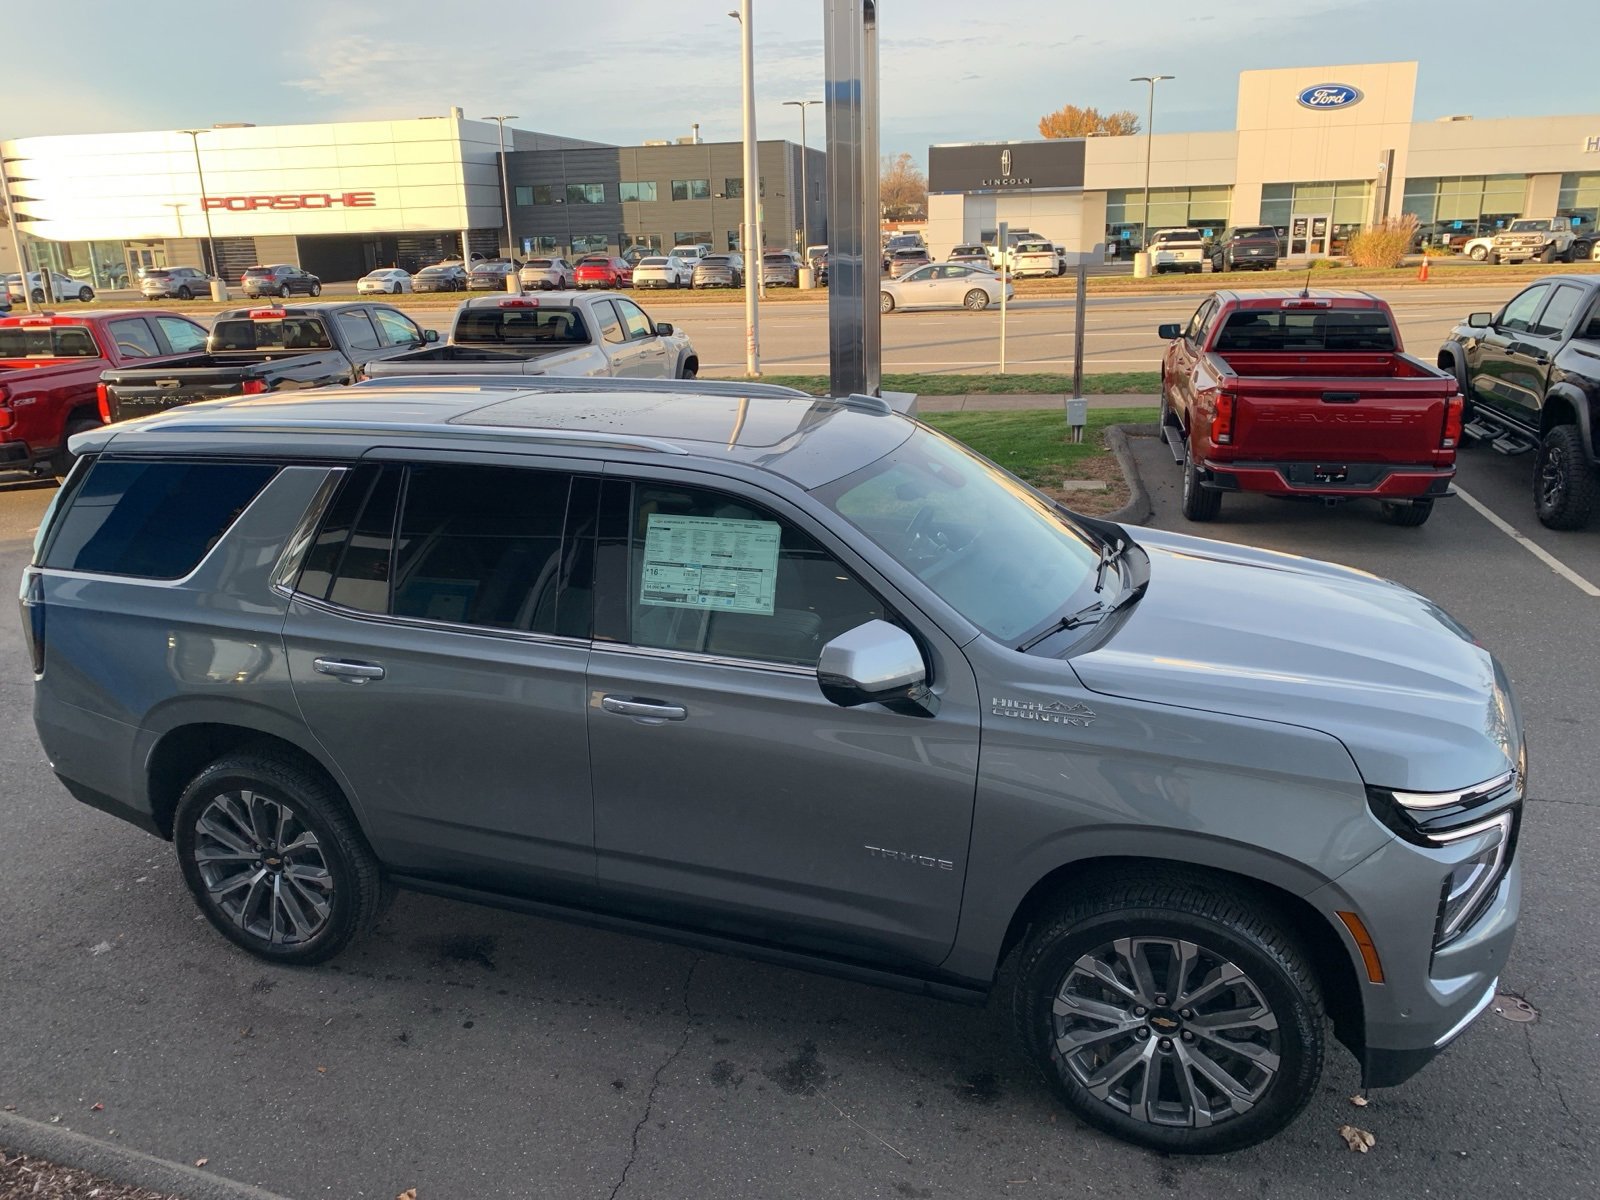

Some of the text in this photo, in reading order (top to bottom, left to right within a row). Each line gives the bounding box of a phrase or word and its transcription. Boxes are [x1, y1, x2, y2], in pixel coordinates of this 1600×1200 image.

[1310, 89, 1347, 105] Ford
[982, 178, 1031, 186] LINCOLN
[200, 191, 377, 212] PORSCHE
[1256, 412, 1423, 424] CHEVROLET
[992, 697, 1044, 711] HIGH
[992, 707, 1096, 727] COUNTRY
[864, 845, 953, 871] TAHOE
